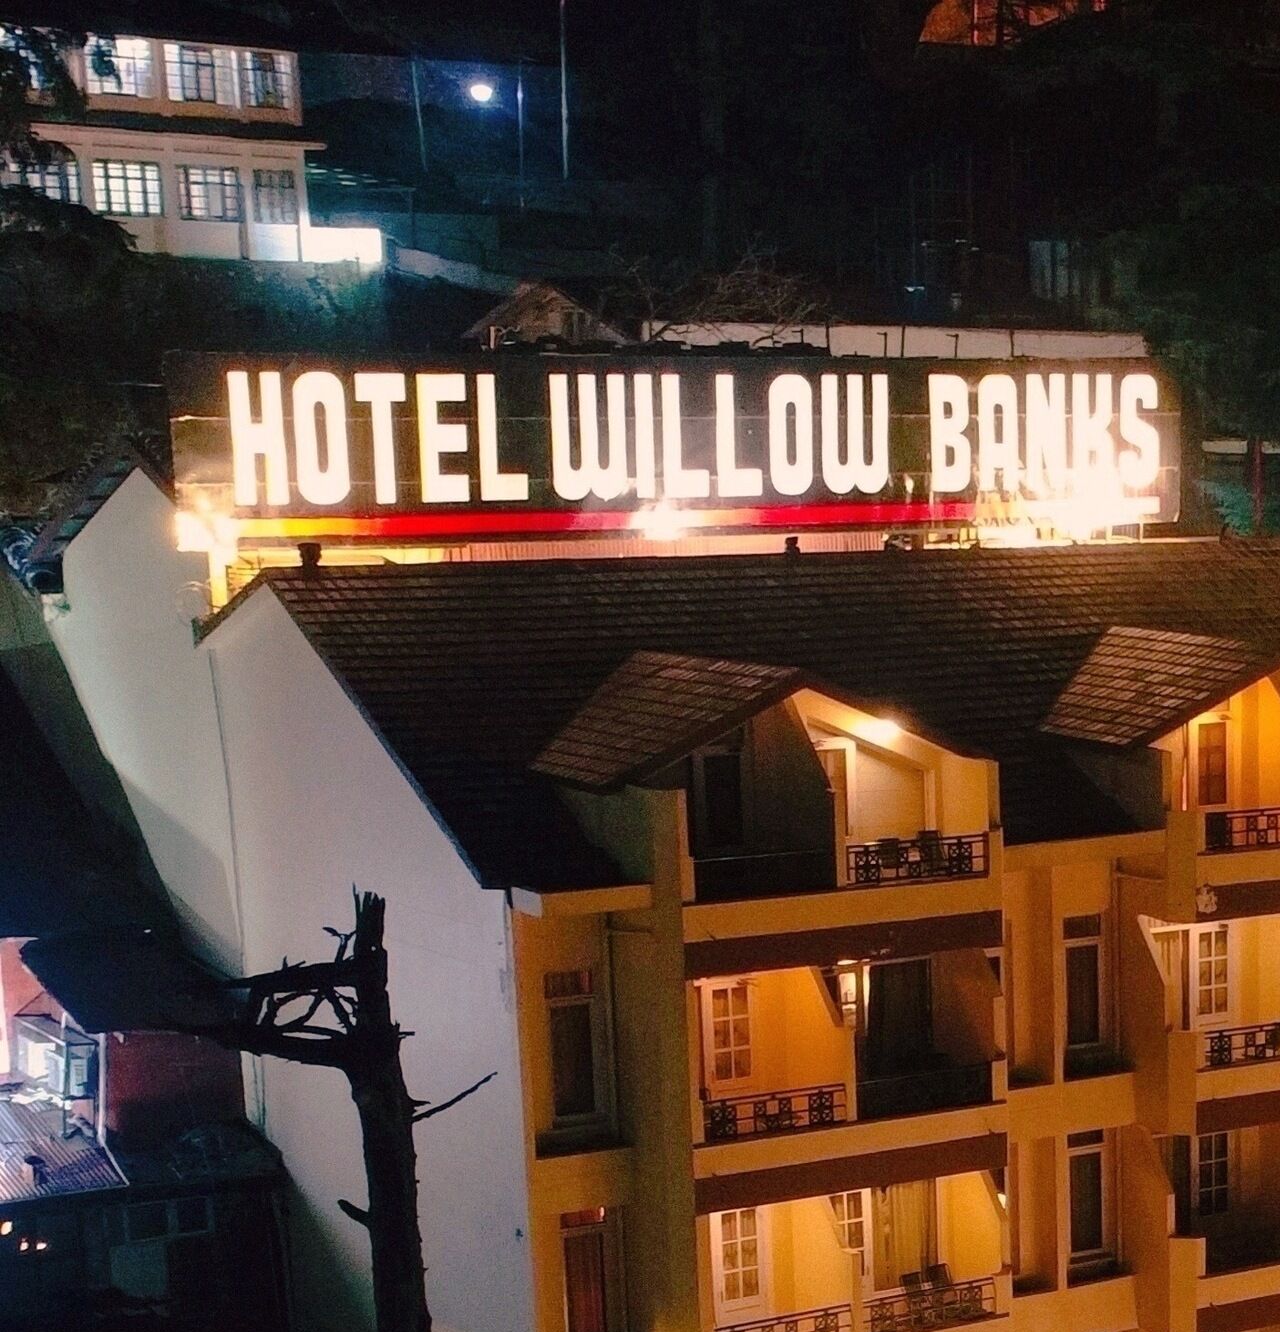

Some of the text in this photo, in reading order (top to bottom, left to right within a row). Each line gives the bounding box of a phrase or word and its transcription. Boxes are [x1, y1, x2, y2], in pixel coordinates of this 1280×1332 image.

[226, 371, 1160, 506] HOTEL WILLOW BANKS
